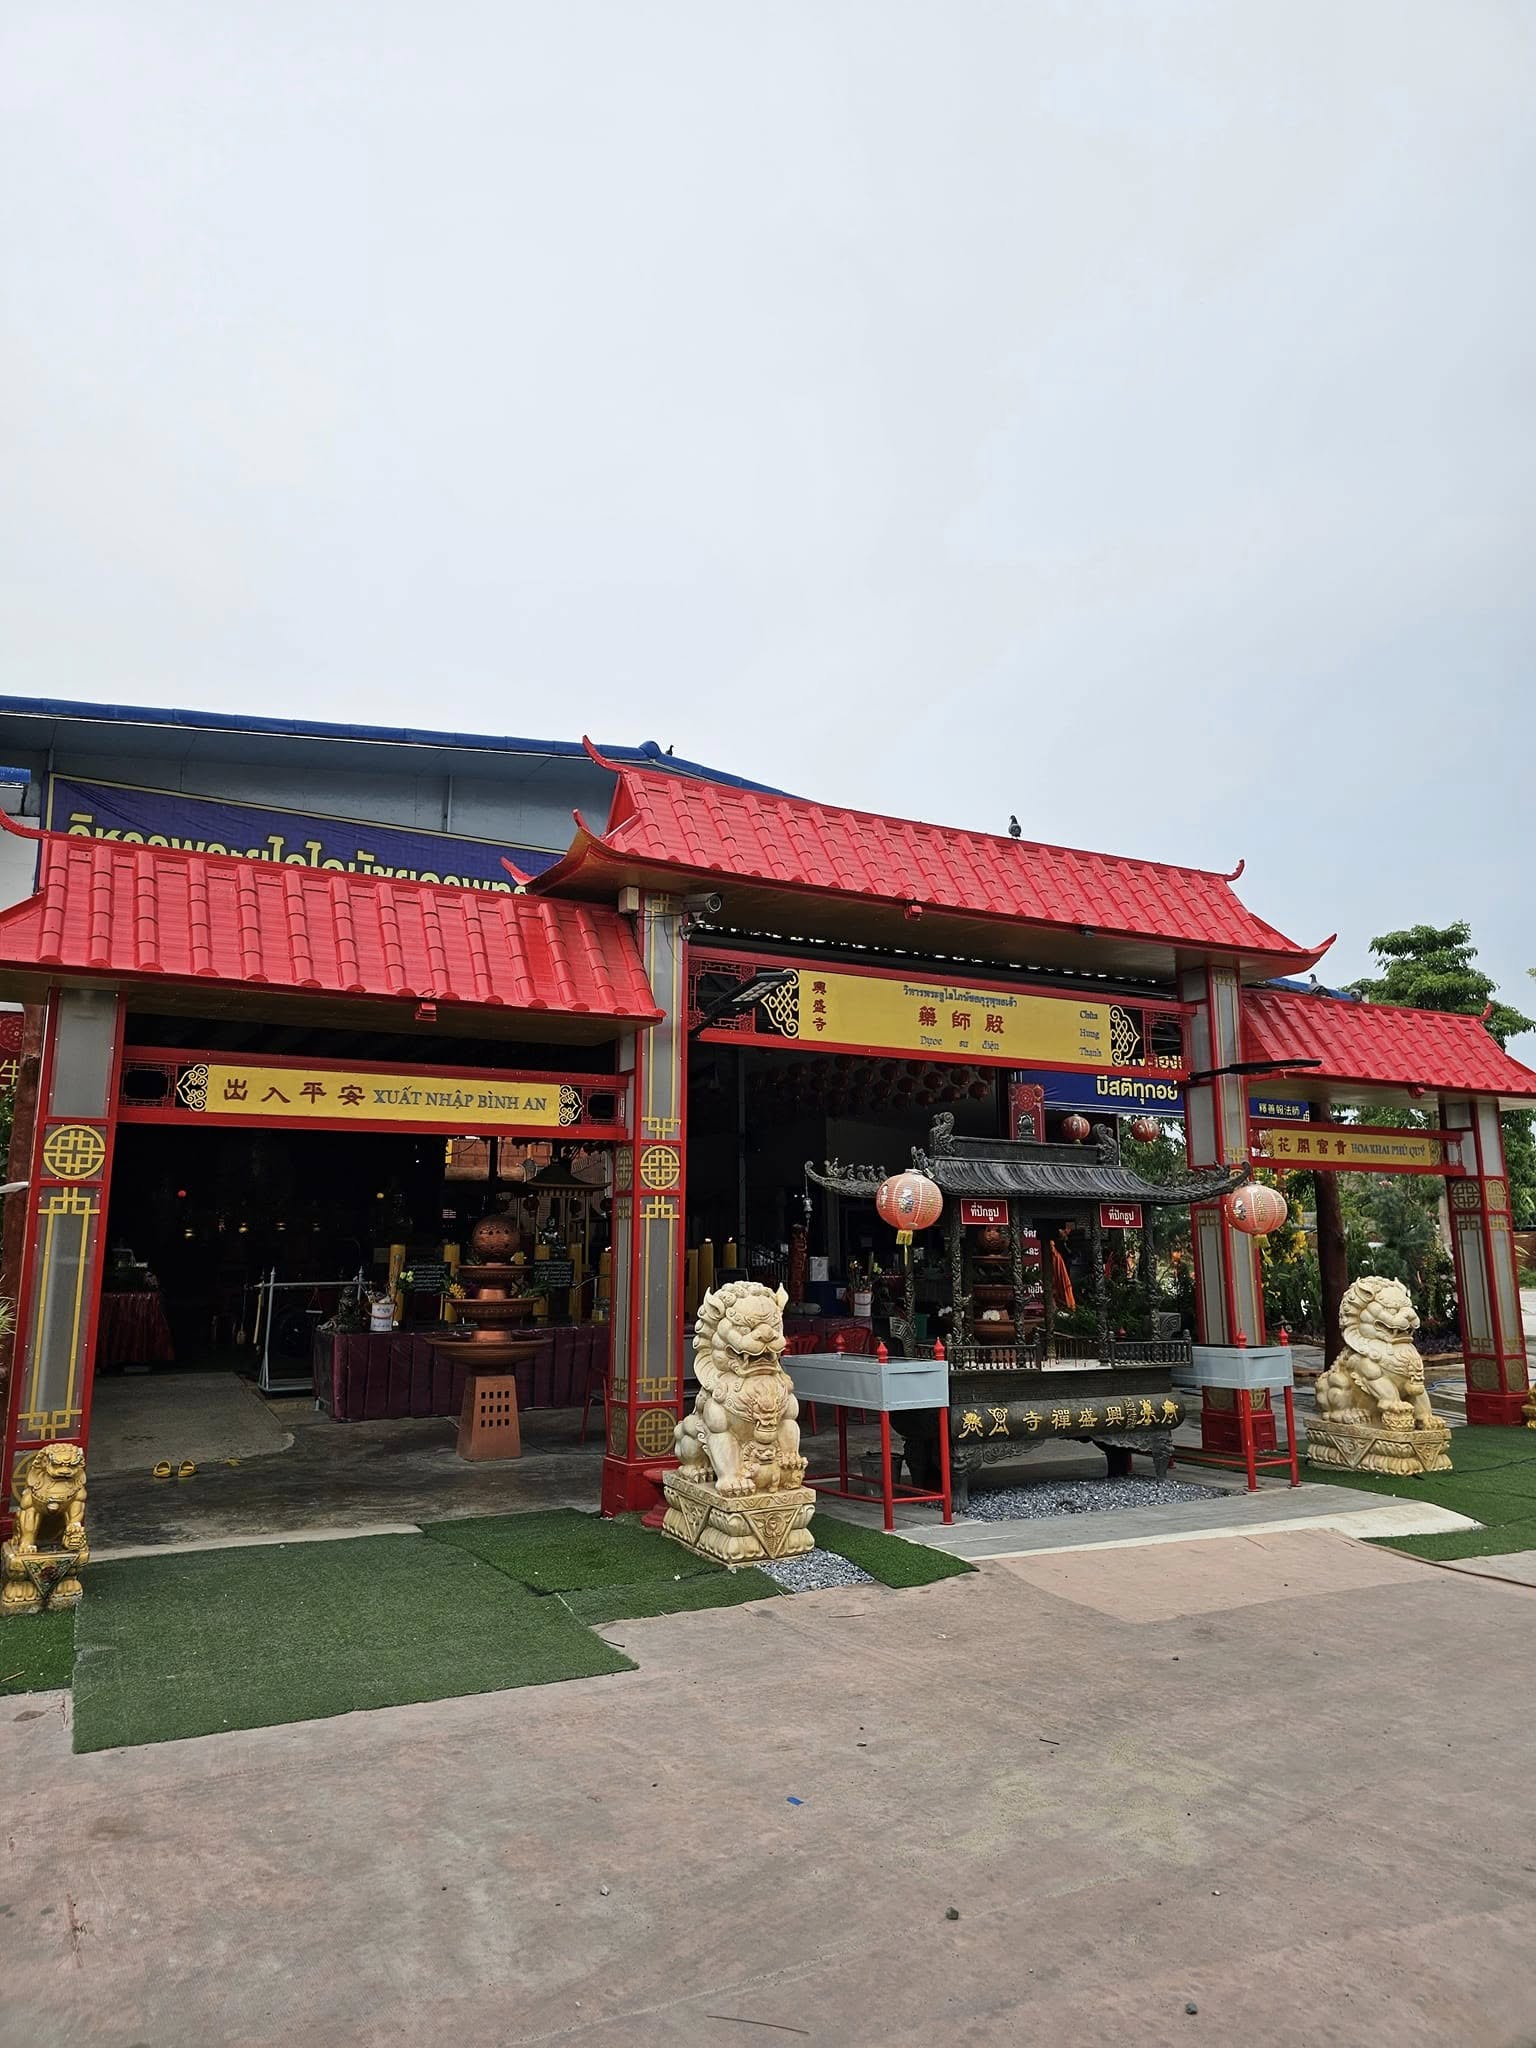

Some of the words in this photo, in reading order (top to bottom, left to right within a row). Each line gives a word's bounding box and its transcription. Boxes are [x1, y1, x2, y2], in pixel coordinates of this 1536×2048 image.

[918, 1006, 1004, 1033] 藥師殿
[223, 1079, 366, 1106] 出入平安
[373, 1086, 422, 1104] XUẤT
[425, 1090, 474, 1109] NHẬP
[477, 1091, 519, 1110] BÌNH
[522, 1097, 547, 1111] AN
[1278, 1137, 1347, 1155] 花開富貴
